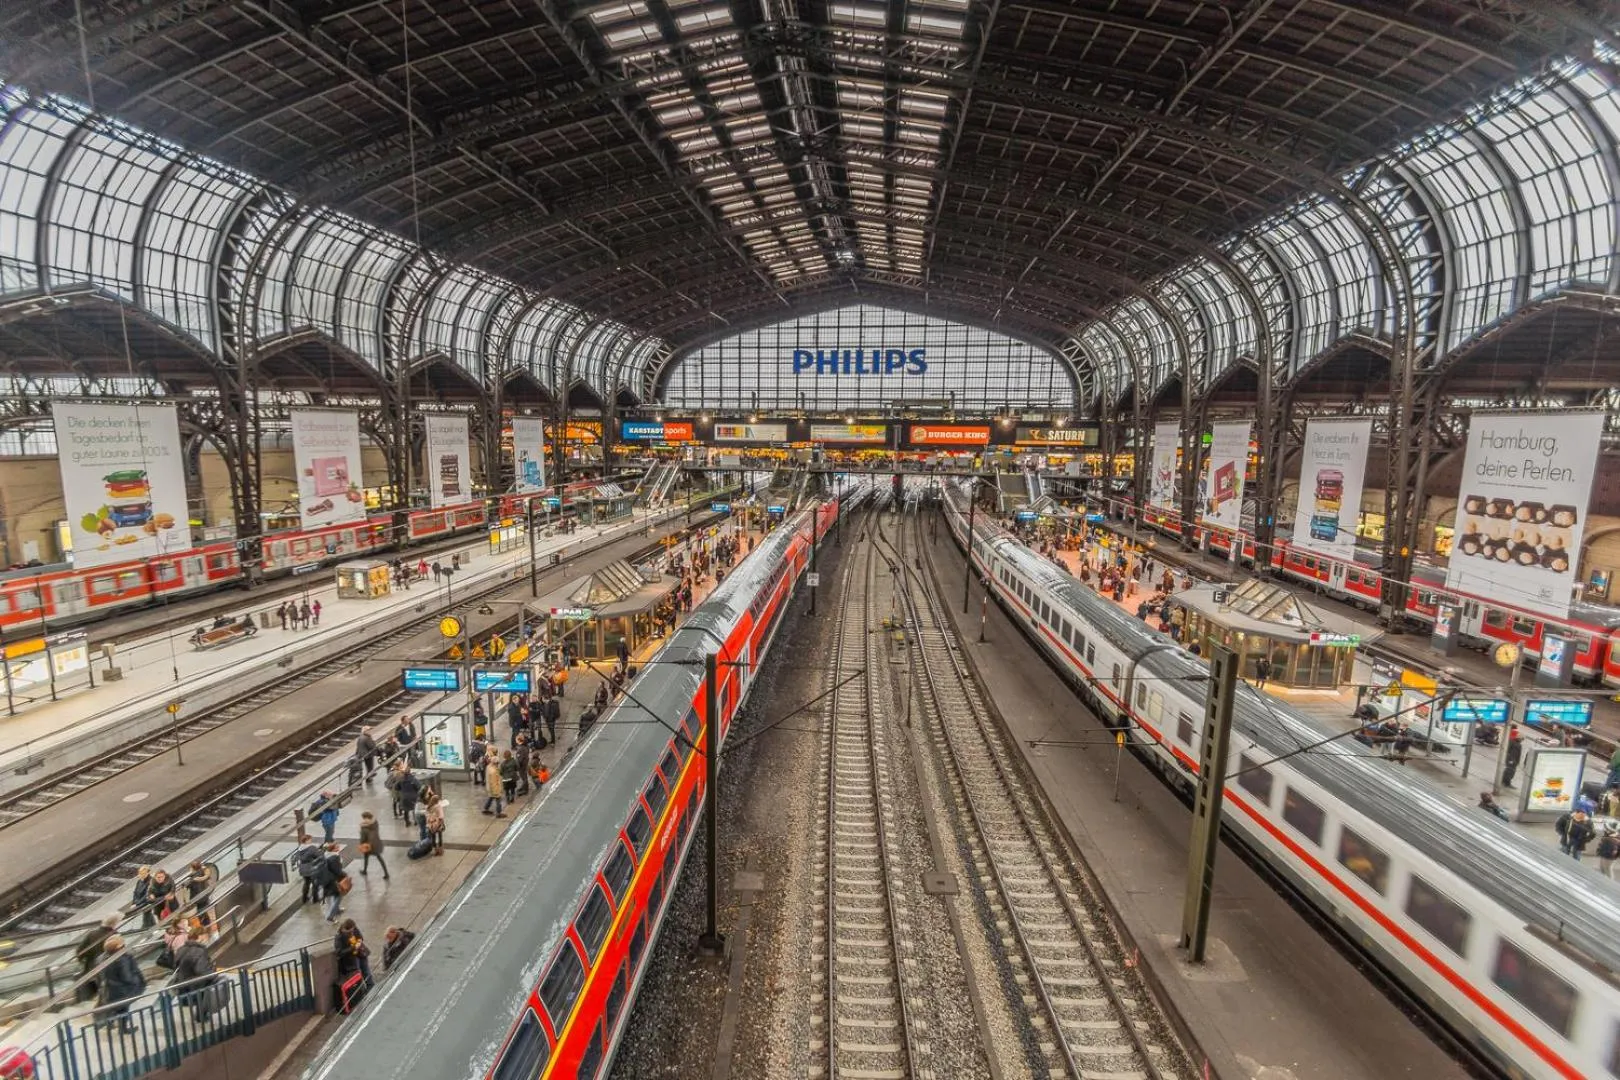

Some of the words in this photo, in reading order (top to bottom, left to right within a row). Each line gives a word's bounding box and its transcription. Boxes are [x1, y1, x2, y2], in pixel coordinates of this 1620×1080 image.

[793, 349, 928, 375] PHILIPS
[67, 416, 86, 428] Die
[88, 416, 126, 428] decken
[664, 427, 687, 435] sports
[1048, 430, 1085, 441] SATURN
[70, 431, 133, 447] Tagesbedarf
[1480, 428, 1559, 457] Hamburg,
[72, 449, 98, 463] guter
[100, 448, 130, 458] Laune
[1476, 456, 1518, 478] deine
[1522, 459, 1575, 482] Perlen.
